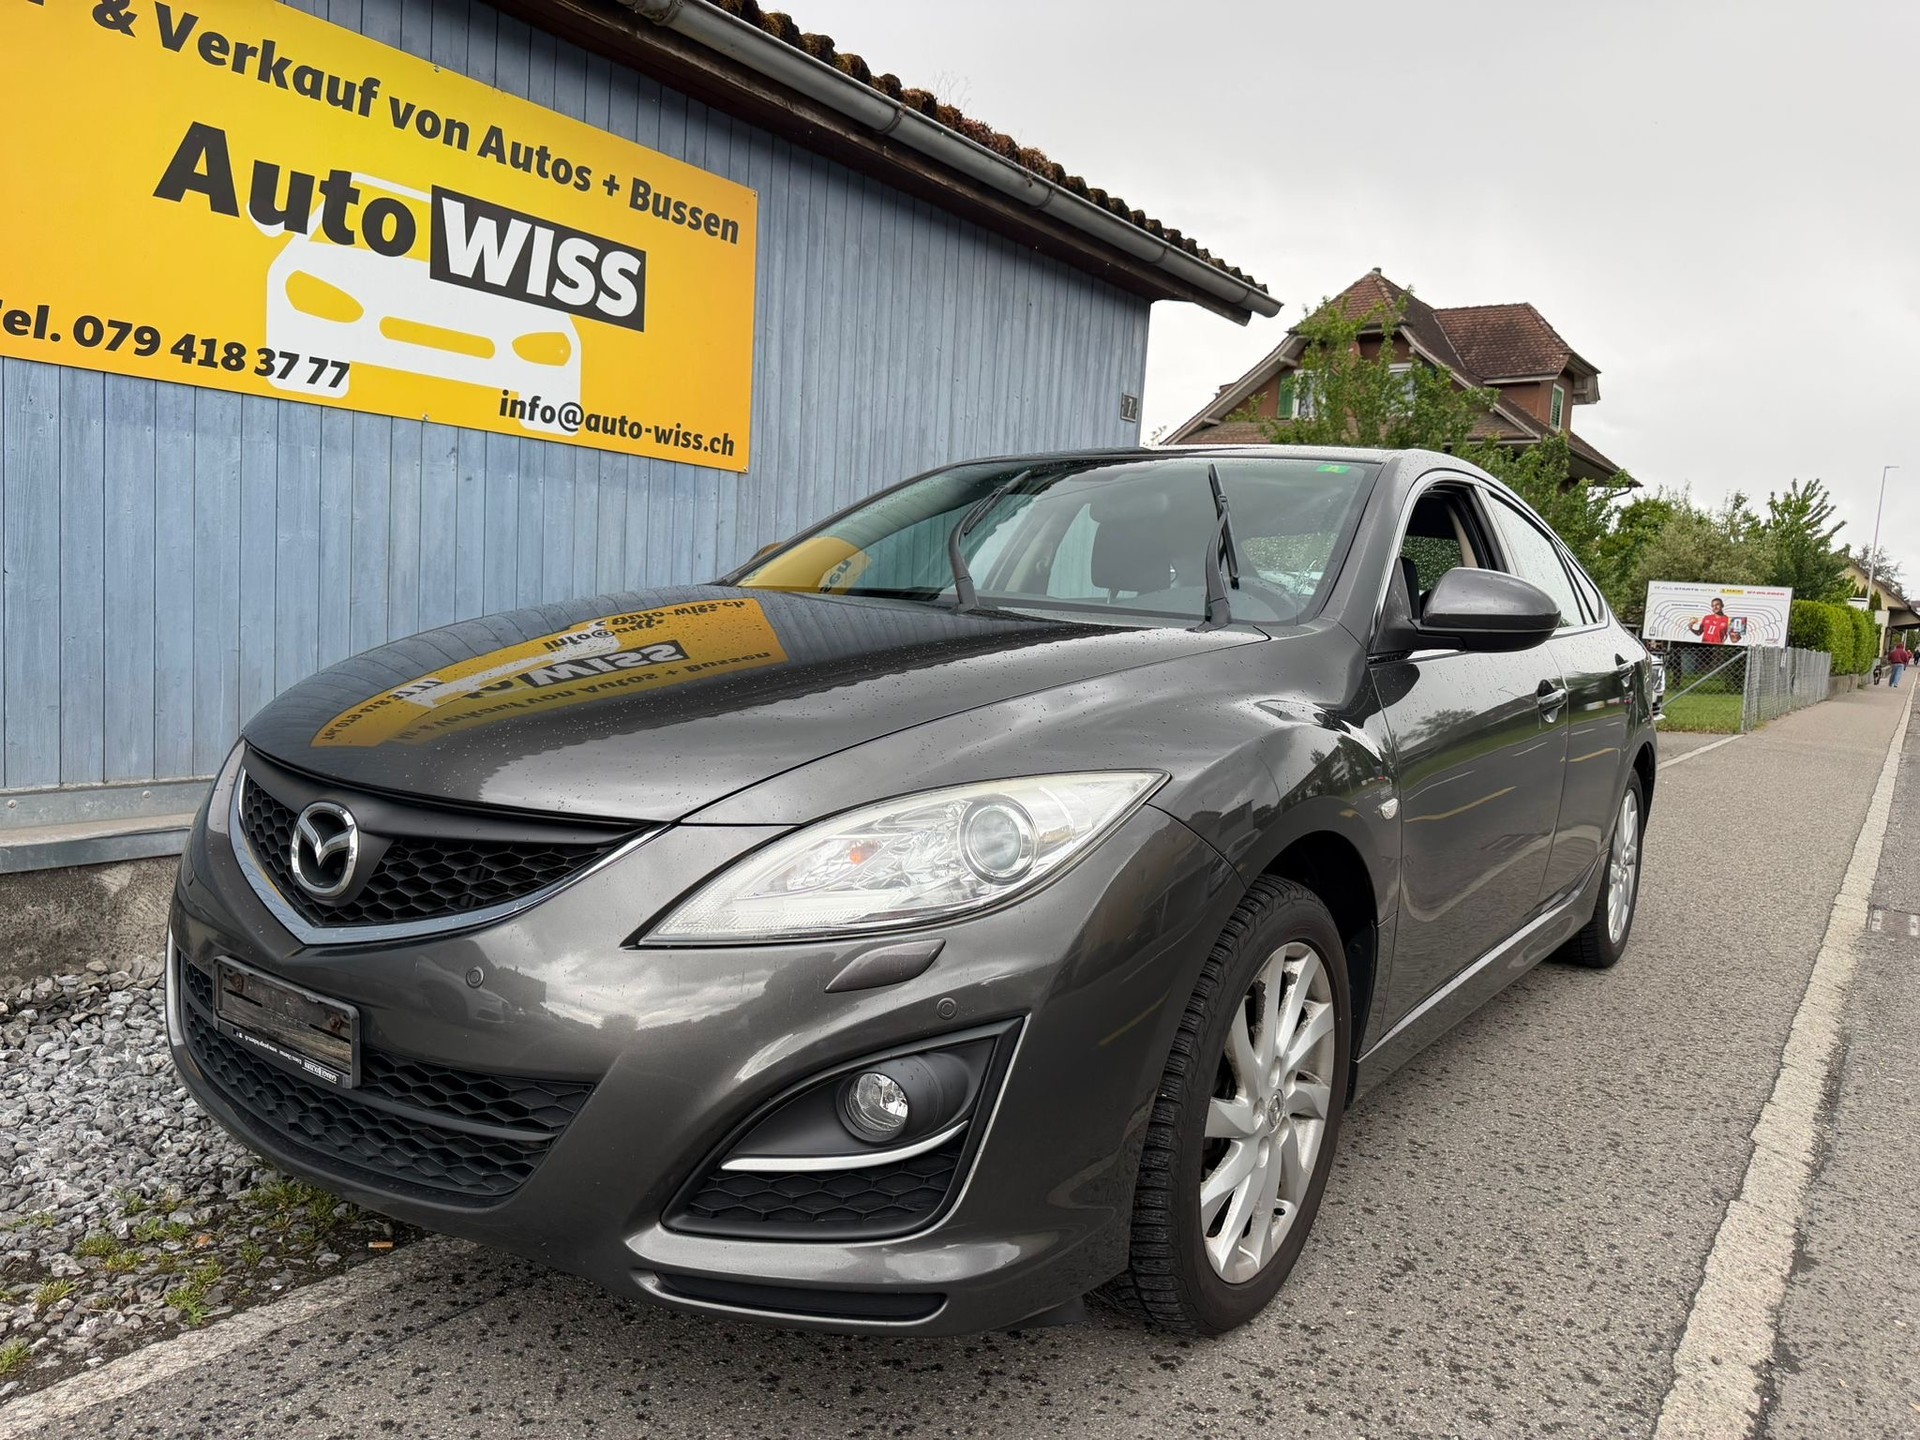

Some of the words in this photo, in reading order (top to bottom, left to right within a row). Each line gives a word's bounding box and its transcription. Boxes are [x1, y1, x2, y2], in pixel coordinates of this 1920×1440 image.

[92, 0, 138, 38] &
[154, 1, 382, 118] Verkauf
[388, 96, 470, 152] von
[477, 124, 593, 192] Autos
[602, 174, 621, 197] +
[628, 176, 739, 245] Bussen
[152, 120, 416, 258] Auto
[441, 196, 642, 318] WISS
[0, 299, 62, 343] el.
[72, 314, 162, 357] 079
[170, 333, 247, 372] 418
[253, 347, 300, 381] 37
[306, 355, 350, 389] 77
[498, 389, 735, 457] info@auto-wiss.ch
